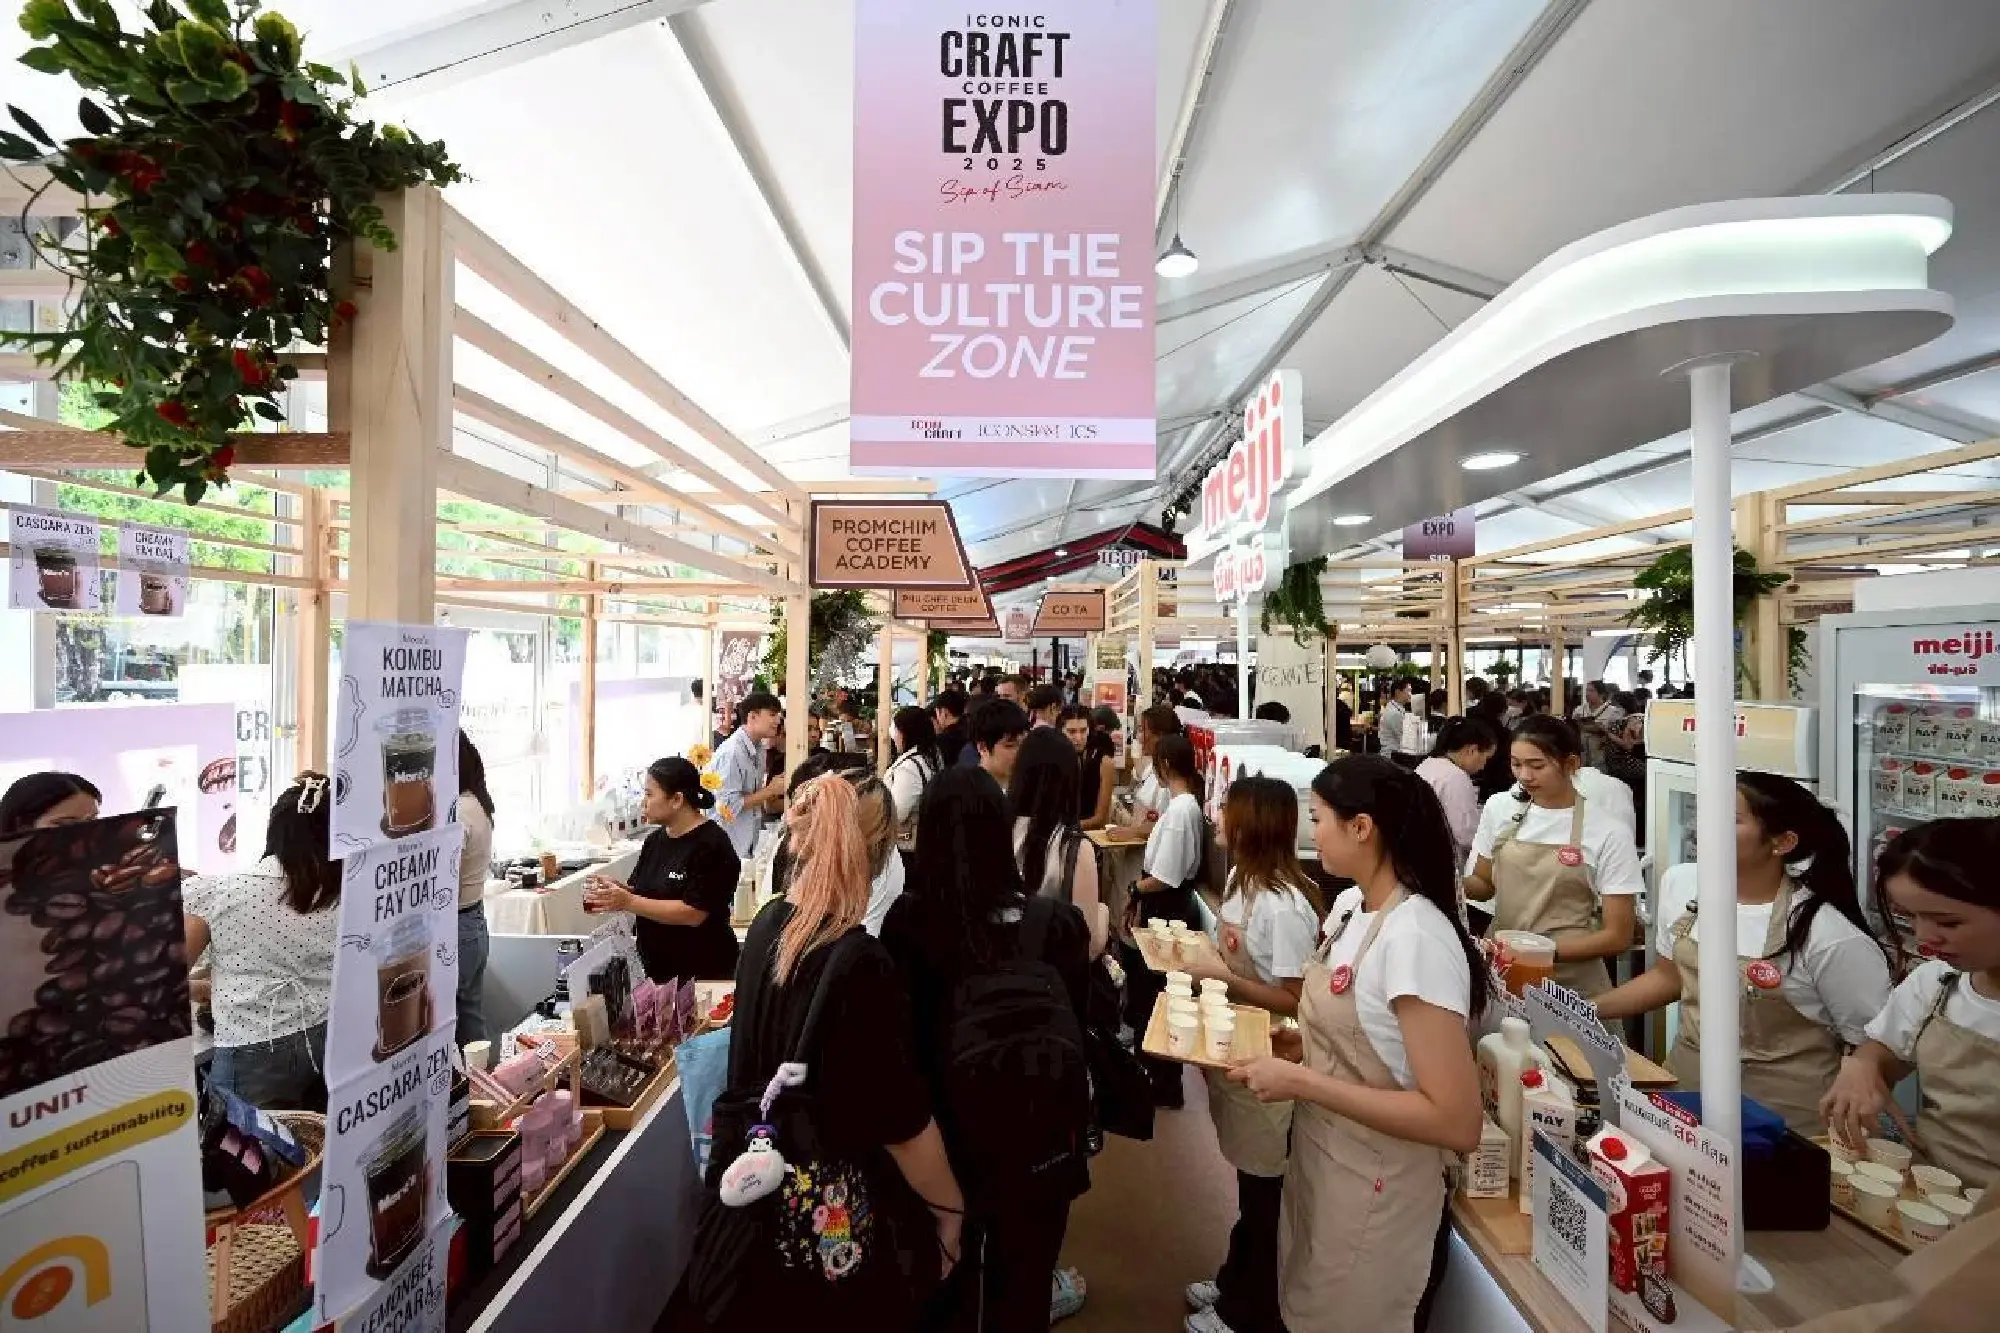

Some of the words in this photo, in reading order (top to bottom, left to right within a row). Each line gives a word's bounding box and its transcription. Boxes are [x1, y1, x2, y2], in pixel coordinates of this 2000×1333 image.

[966, 14, 1046, 28] ICONIC
[940, 30, 1070, 78] CRAFT
[961, 82, 1049, 95] COFFEE
[943, 98, 1068, 156] EXPO
[963, 158, 1047, 171] 2025
[939, 179, 977, 204] Sip
[982, 180, 1000, 202] of
[893, 230, 985, 275] SIP
[1003, 232, 1120, 278] THE
[869, 281, 1143, 329] CULTURE
[918, 333, 1096, 379] ZONE
[1204, 380, 1283, 533] meiji
[16, 515, 70, 535] CASCARA
[832, 519, 936, 535] PROMCHIM
[1422, 521, 1456, 536] EXPO
[846, 537, 922, 553] COFFEE
[835, 554, 932, 570] ACADEMY
[1913, 631, 1993, 659] meiji
[383, 648, 442, 671] KOMBU
[382, 676, 442, 698] MATCHA
[374, 847, 440, 890] CREAMY
[374, 889, 406, 922] FAY
[410, 875, 438, 908] OAT
[336, 1063, 422, 1136] CASCARA
[426, 1043, 450, 1079] ZEN
[10, 1085, 88, 1129] UNIT
[1532, 1112, 1566, 1128] RAY
[65, 1102, 187, 1156] sustainability
